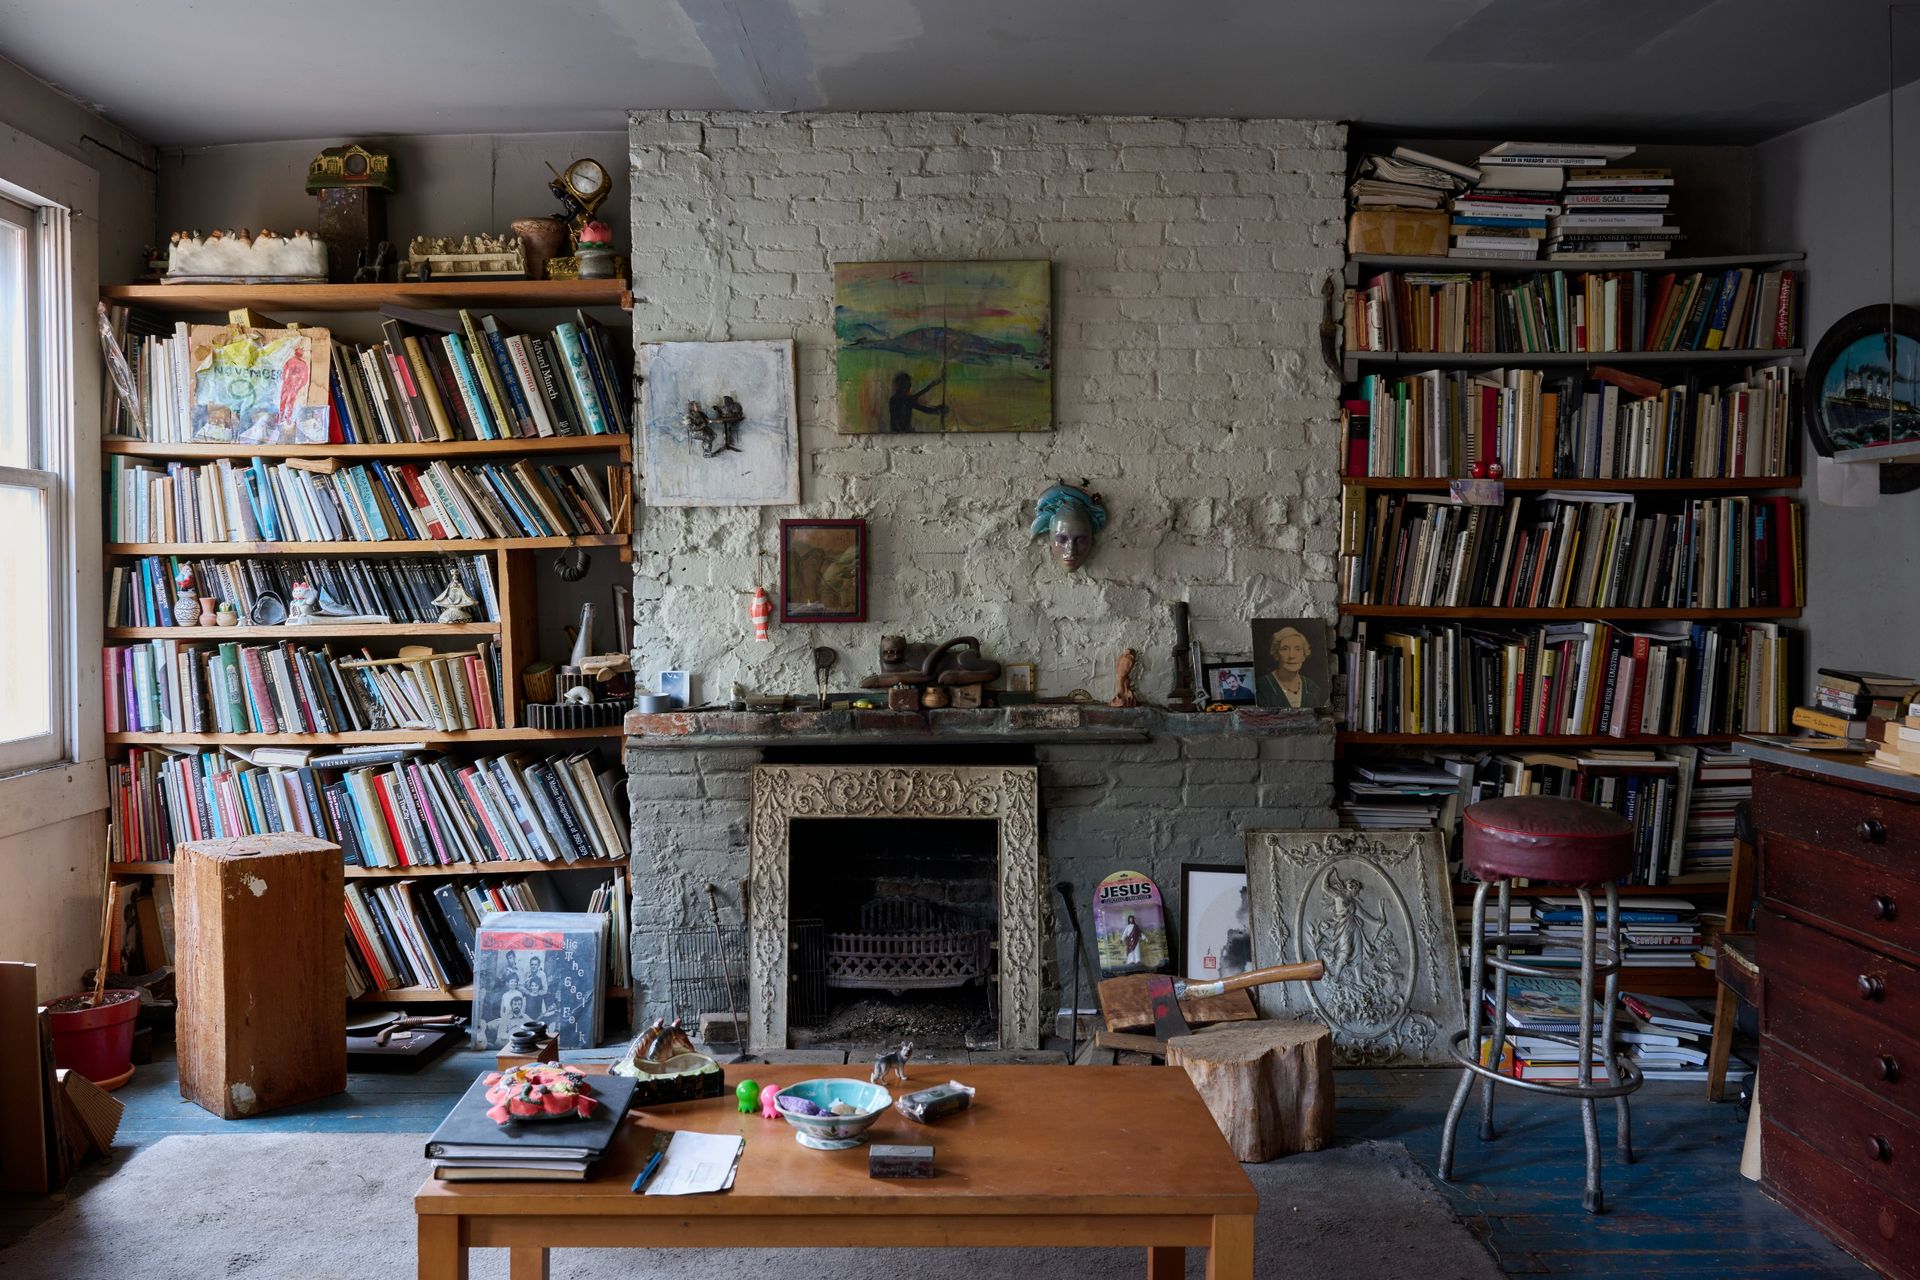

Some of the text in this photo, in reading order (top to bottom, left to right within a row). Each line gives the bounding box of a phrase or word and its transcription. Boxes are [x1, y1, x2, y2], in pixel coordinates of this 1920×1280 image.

[513, 339, 535, 392] JOHN HEARTFIELD
[531, 338, 559, 400] Edvard Munch
[435, 504, 449, 528] AMERICANS
[1604, 686, 1612, 703] PARIS
[1629, 639, 1645, 731] ONE KEN OHARA
[1600, 709, 1609, 732] SKETCH
[319, 759, 349, 767] VIETNAM
[405, 776, 415, 793] HARLEM
[545, 772, 553, 780] 54
[547, 778, 561, 796] Master
[554, 794, 575, 828] Photographers
[572, 831, 589, 857] 1960-1979
[1100, 882, 1151, 899] JESUS
[1635, 936, 1672, 944] COWBOY UP
